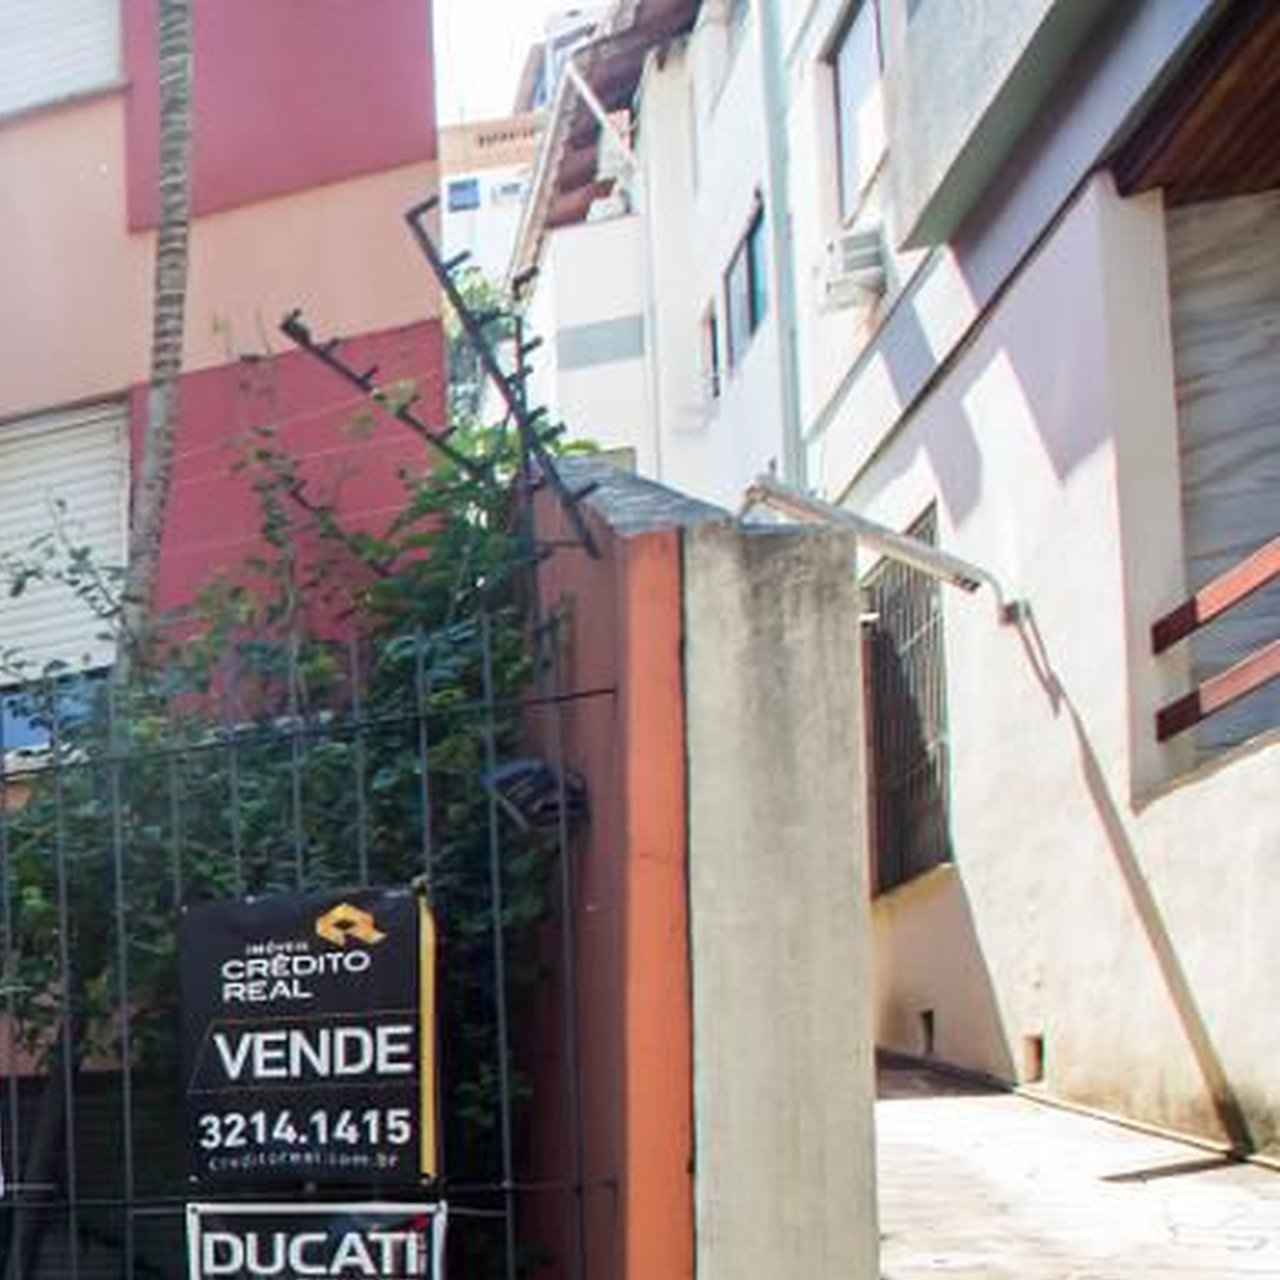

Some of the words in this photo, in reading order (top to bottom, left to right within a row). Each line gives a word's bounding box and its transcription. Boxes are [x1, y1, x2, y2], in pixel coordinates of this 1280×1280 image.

[222, 951, 370, 980] CRÉDITO
[223, 980, 313, 1002] REAL
[213, 1025, 414, 1080] VENDE
[199, 1108, 412, 1149] 3214.1415
[202, 1231, 418, 1276] DUCATI
